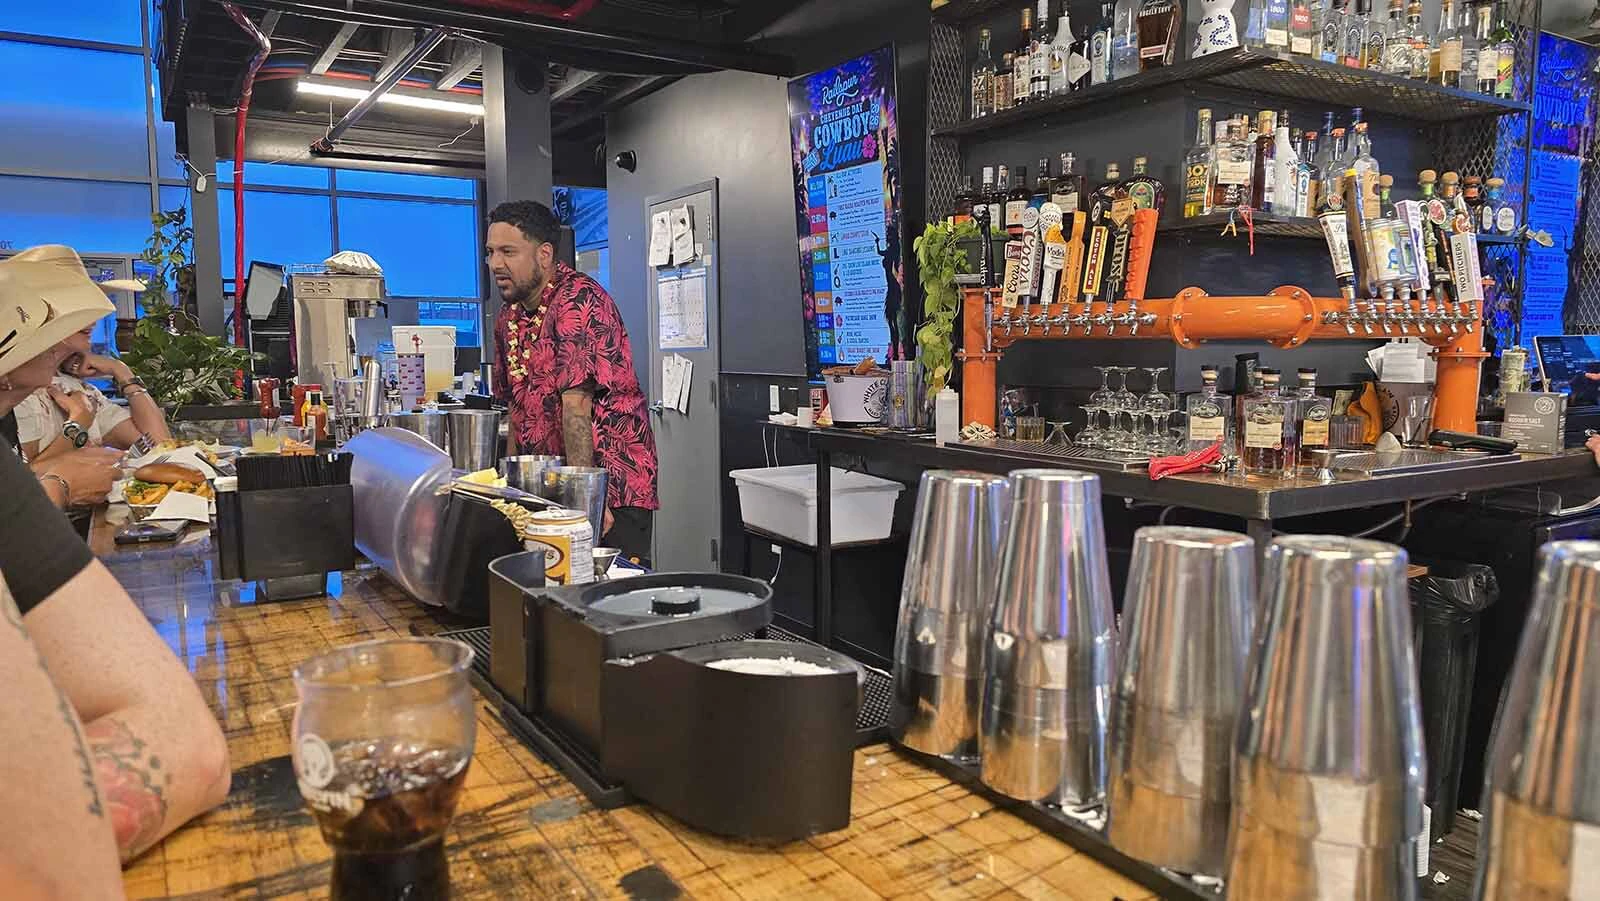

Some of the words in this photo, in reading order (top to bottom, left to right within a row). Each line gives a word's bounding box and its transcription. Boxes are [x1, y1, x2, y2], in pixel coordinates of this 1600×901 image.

[822, 75, 859, 106] Railspur
[851, 102, 864, 116] DAY
[1534, 94, 1578, 125] OWBOY
[813, 111, 871, 149] COWBOY
[1091, 231, 1101, 264] SCOTCH
[1455, 242, 1466, 277] PITCHERS
[980, 259, 989, 285] nitro
[1006, 264, 1021, 293] Coors
[863, 380, 880, 405] WHITE
